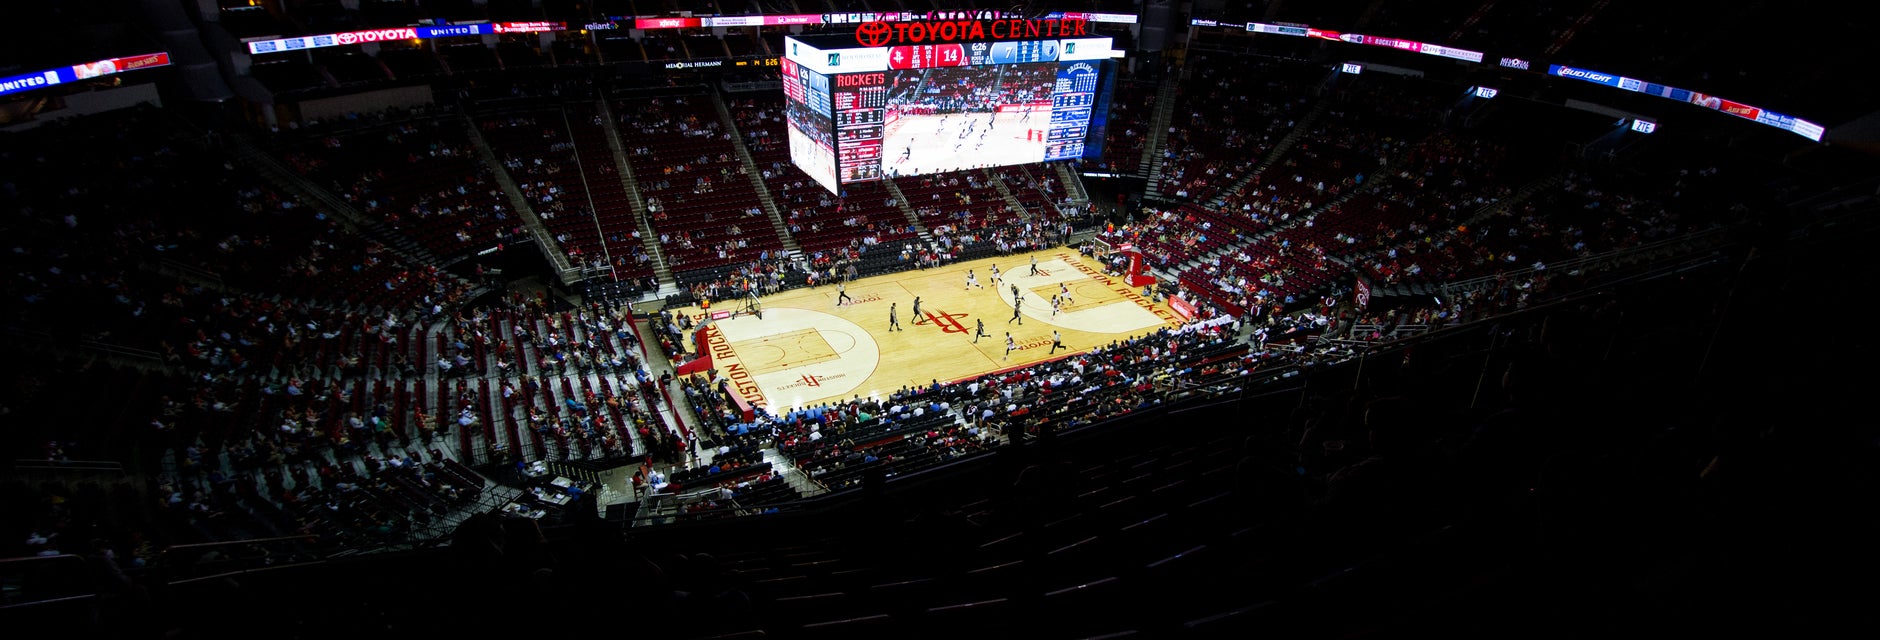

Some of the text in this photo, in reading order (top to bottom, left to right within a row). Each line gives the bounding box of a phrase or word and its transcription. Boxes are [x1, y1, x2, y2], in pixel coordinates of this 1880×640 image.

[660, 19, 680, 28] xfinity
[354, 28, 417, 42] TOYOTA
[431, 27, 468, 36] UNITED
[895, 18, 1086, 43] TOYOTA CENTER
[972, 43, 986, 51] 6:26
[1005, 46, 1013, 59] 7
[944, 49, 957, 62] 14
[1346, 64, 1357, 73] ZTE
[836, 73, 885, 88] ROCKETS
[1563, 68, 1612, 83] BUD LIGHT
[1480, 88, 1493, 98] ZTE
[1636, 121, 1651, 133] ZTE
[1055, 252, 1117, 286] HOUSTON
[1115, 287, 1183, 326] ROCKETS
